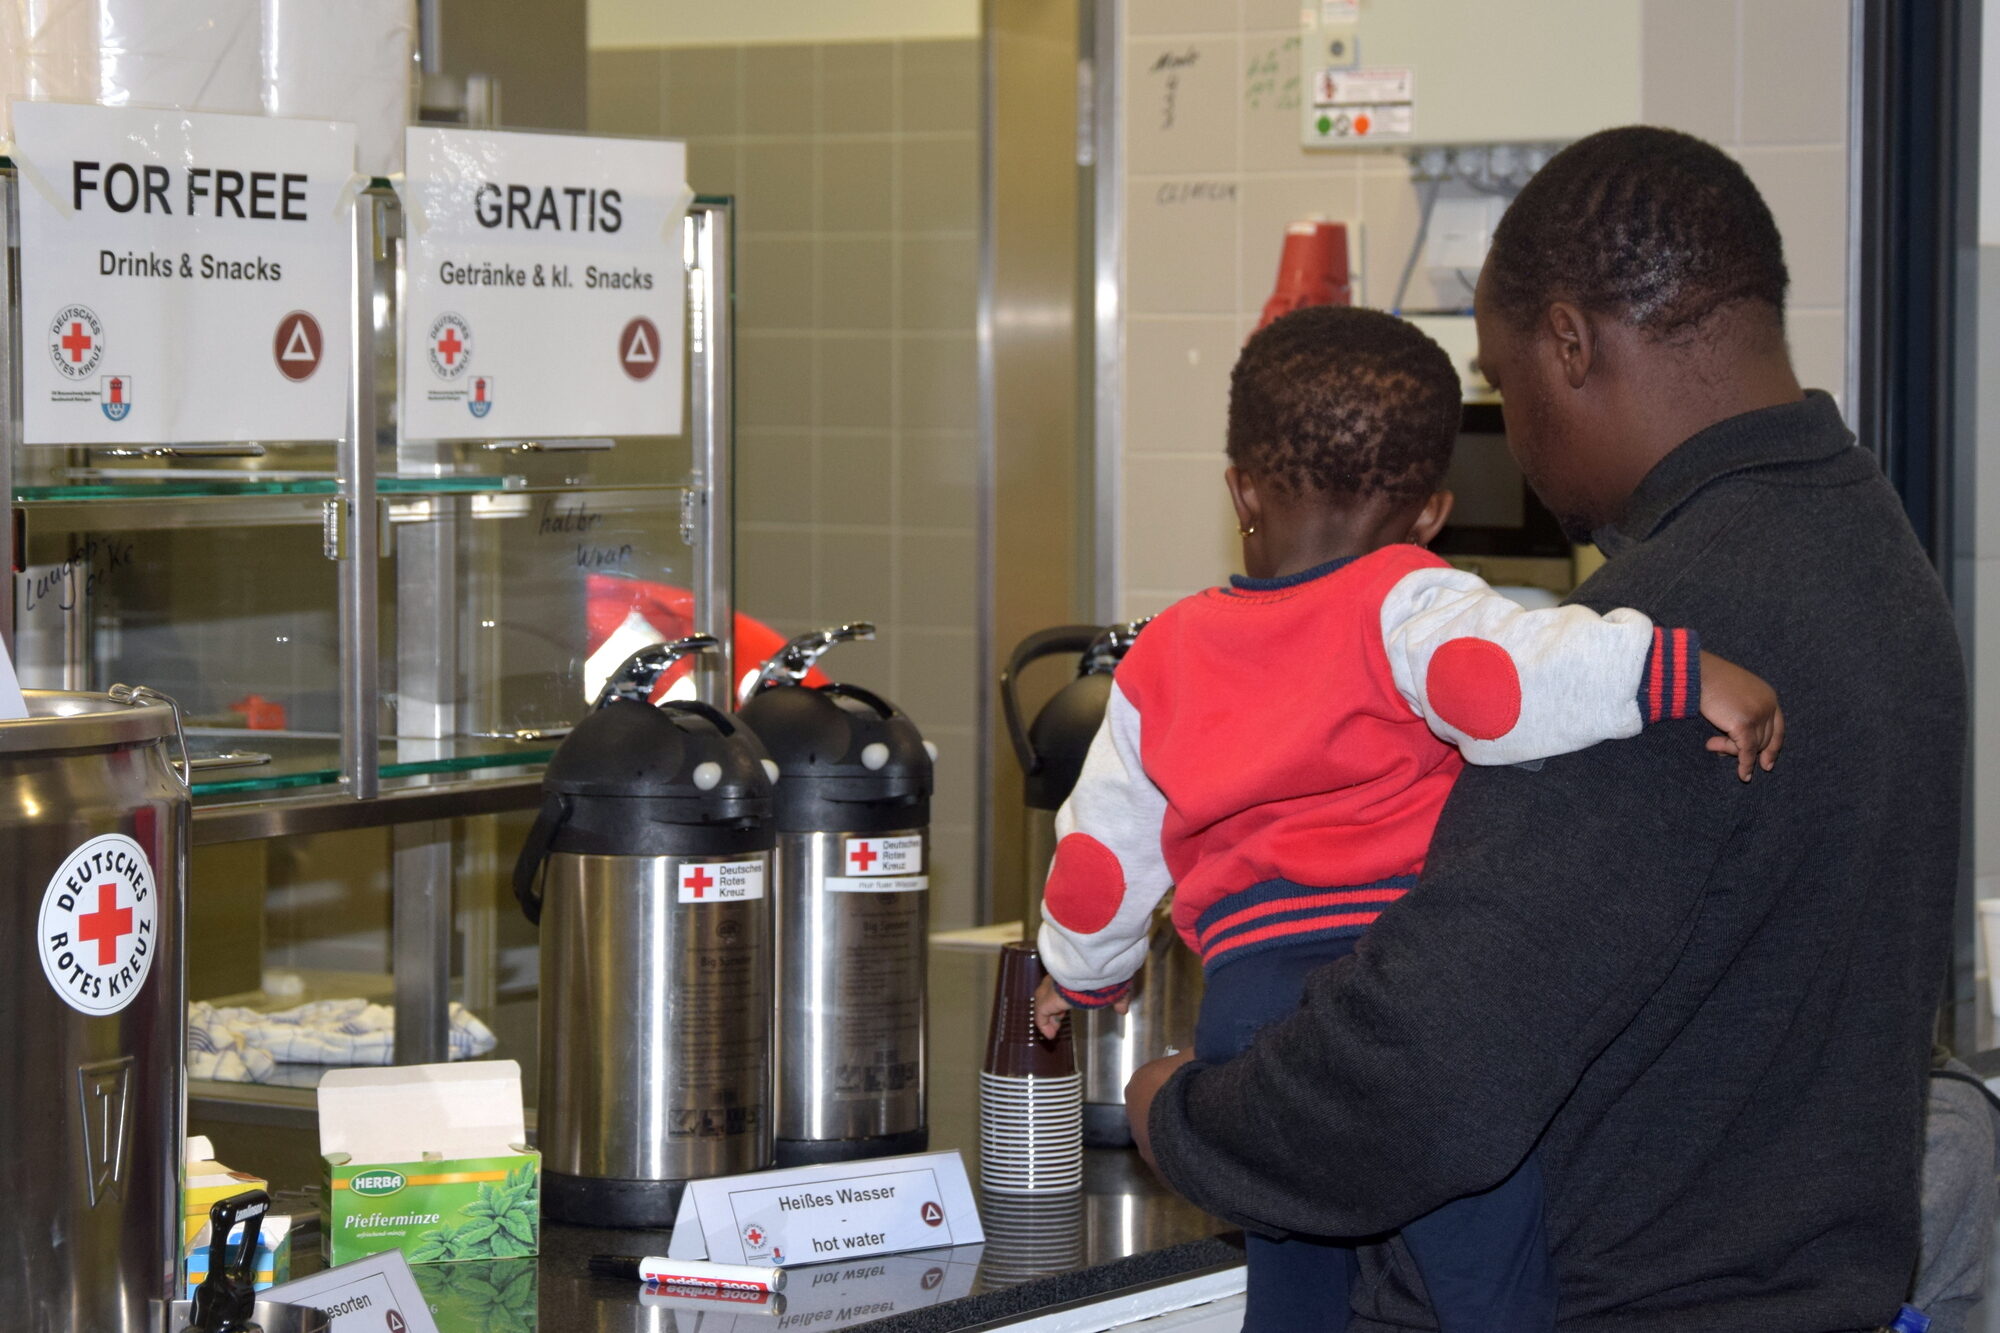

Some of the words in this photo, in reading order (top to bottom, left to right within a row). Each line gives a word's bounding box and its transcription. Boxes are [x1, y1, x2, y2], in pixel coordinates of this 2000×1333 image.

[73, 160, 173, 215] FOR
[187, 168, 308, 221] FREE
[474, 182, 623, 233] GRATIS
[100, 250, 173, 278] Drinks
[180, 253, 194, 279] &
[200, 254, 282, 281] Snacks
[440, 261, 526, 288] Getränke
[532, 264, 546, 288] &
[552, 266, 573, 288] kl.
[585, 266, 653, 290] Snacks
[52, 307, 101, 336] DEUTSCHES
[51, 343, 75, 376] ROTES
[77, 344, 102, 376] KREUZ
[882, 839, 920, 850] Deutsches
[882, 851, 906, 860] Rotes
[719, 864, 762, 875] Deutsches
[882, 861, 906, 871] Kreuz
[57, 850, 148, 912] DEUTSCHES
[719, 876, 746, 887] Rotes
[719, 888, 745, 898] Kreuz
[51, 931, 101, 998] ROTES
[108, 918, 151, 997] KREUZ
[355, 1175, 402, 1190] HERBA
[778, 1193, 834, 1212] Heißes
[836, 1186, 896, 1204] Wasser
[344, 1211, 440, 1229] Pfefferminze
[812, 1236, 840, 1253] hot
[842, 1232, 886, 1249] water
